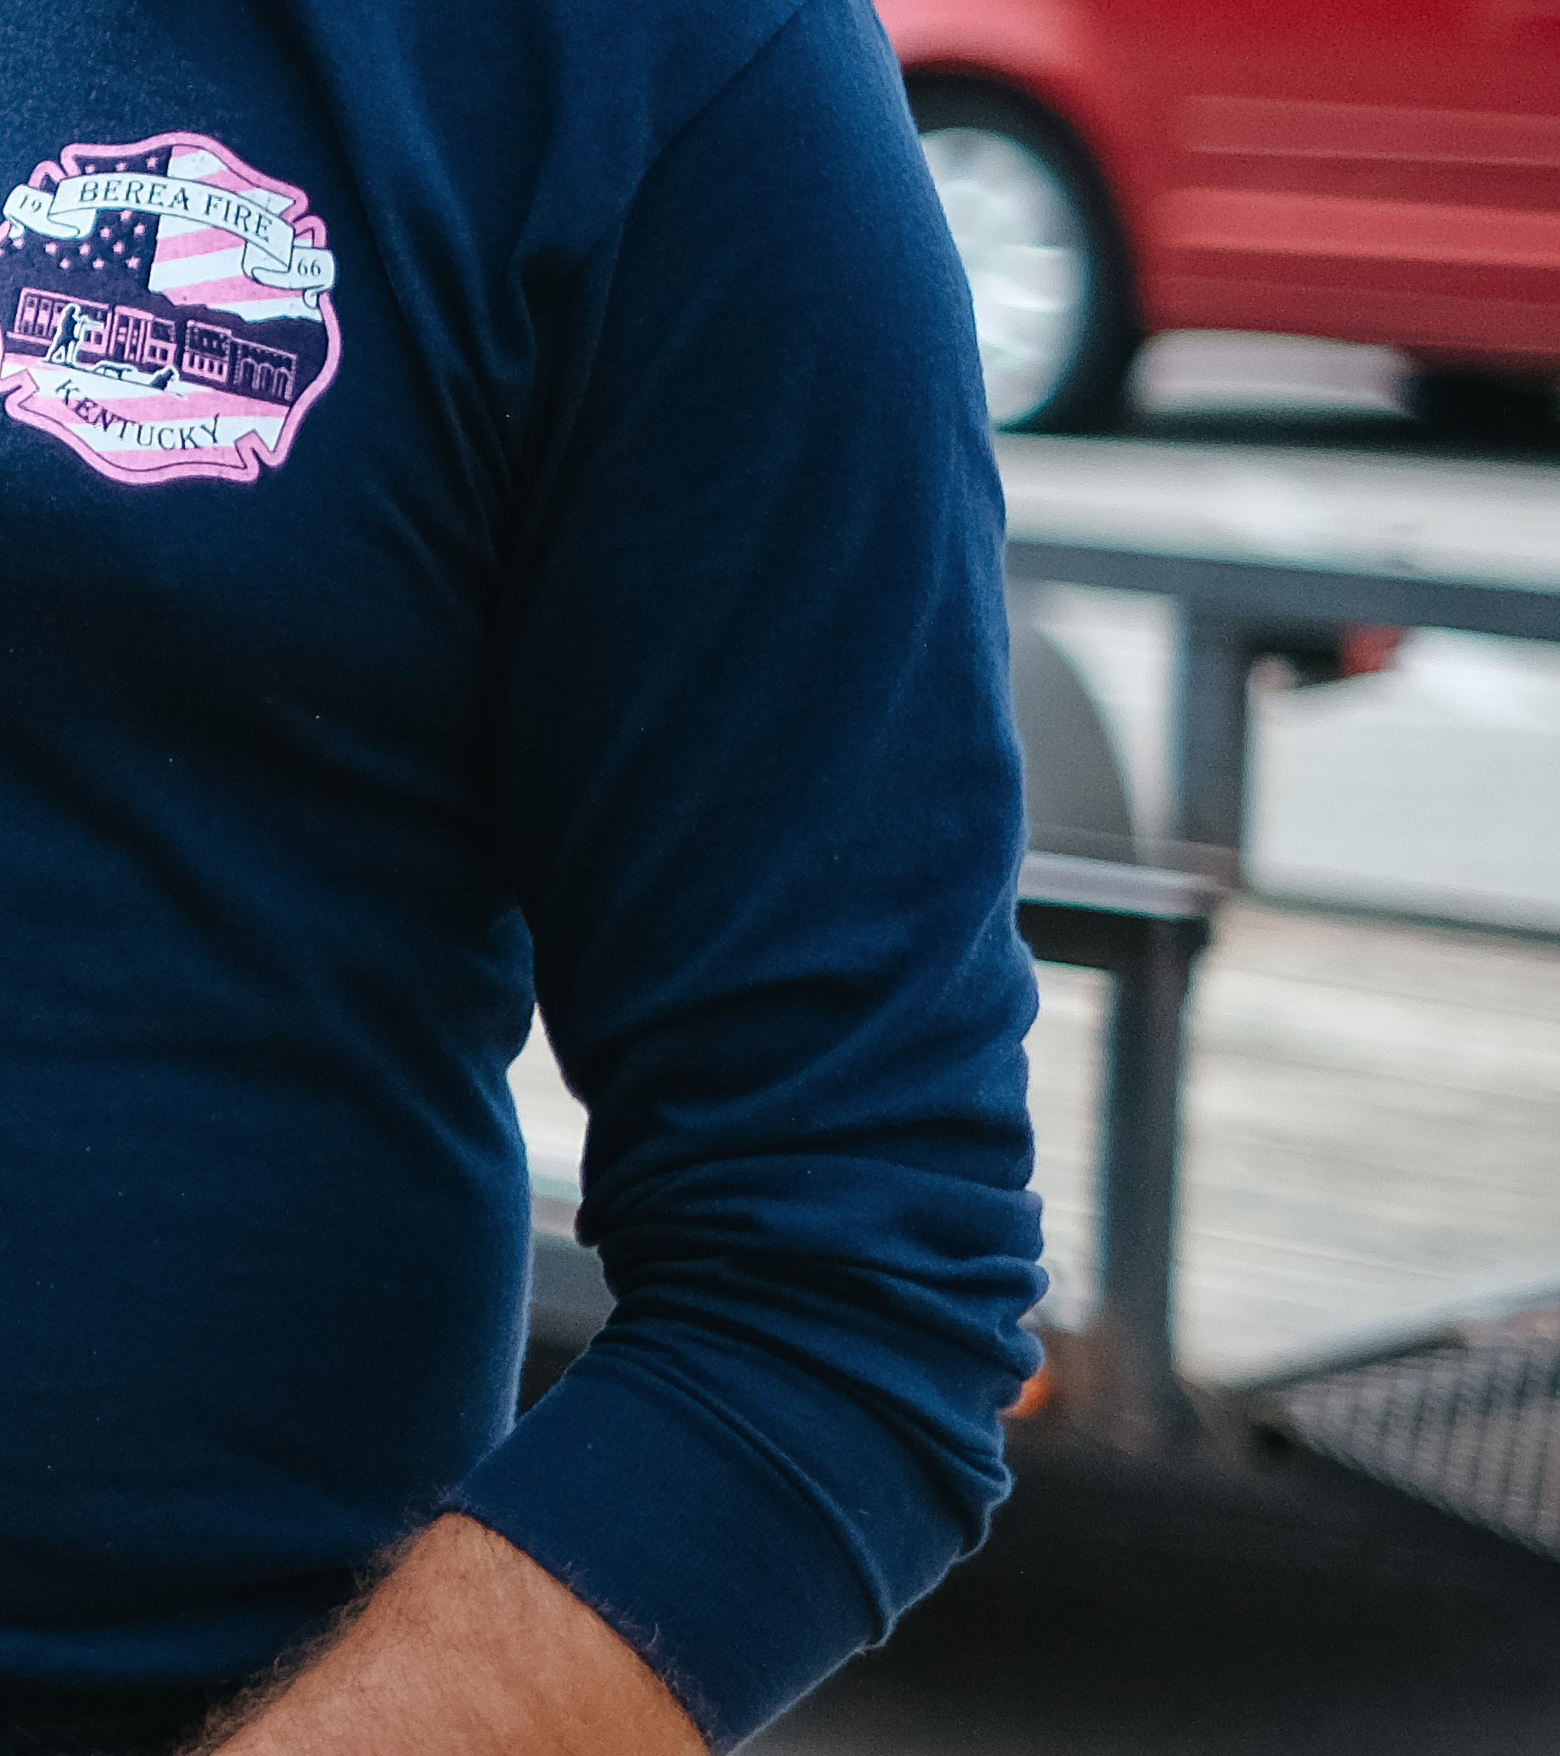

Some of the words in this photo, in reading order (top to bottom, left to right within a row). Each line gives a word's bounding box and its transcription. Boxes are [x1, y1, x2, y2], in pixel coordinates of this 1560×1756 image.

[17, 193, 42, 215] 19
[78, 179, 190, 213] BEREA
[203, 195, 273, 244] FIRE
[296, 258, 323, 278] 66
[53, 378, 221, 452] KENTUCKY
